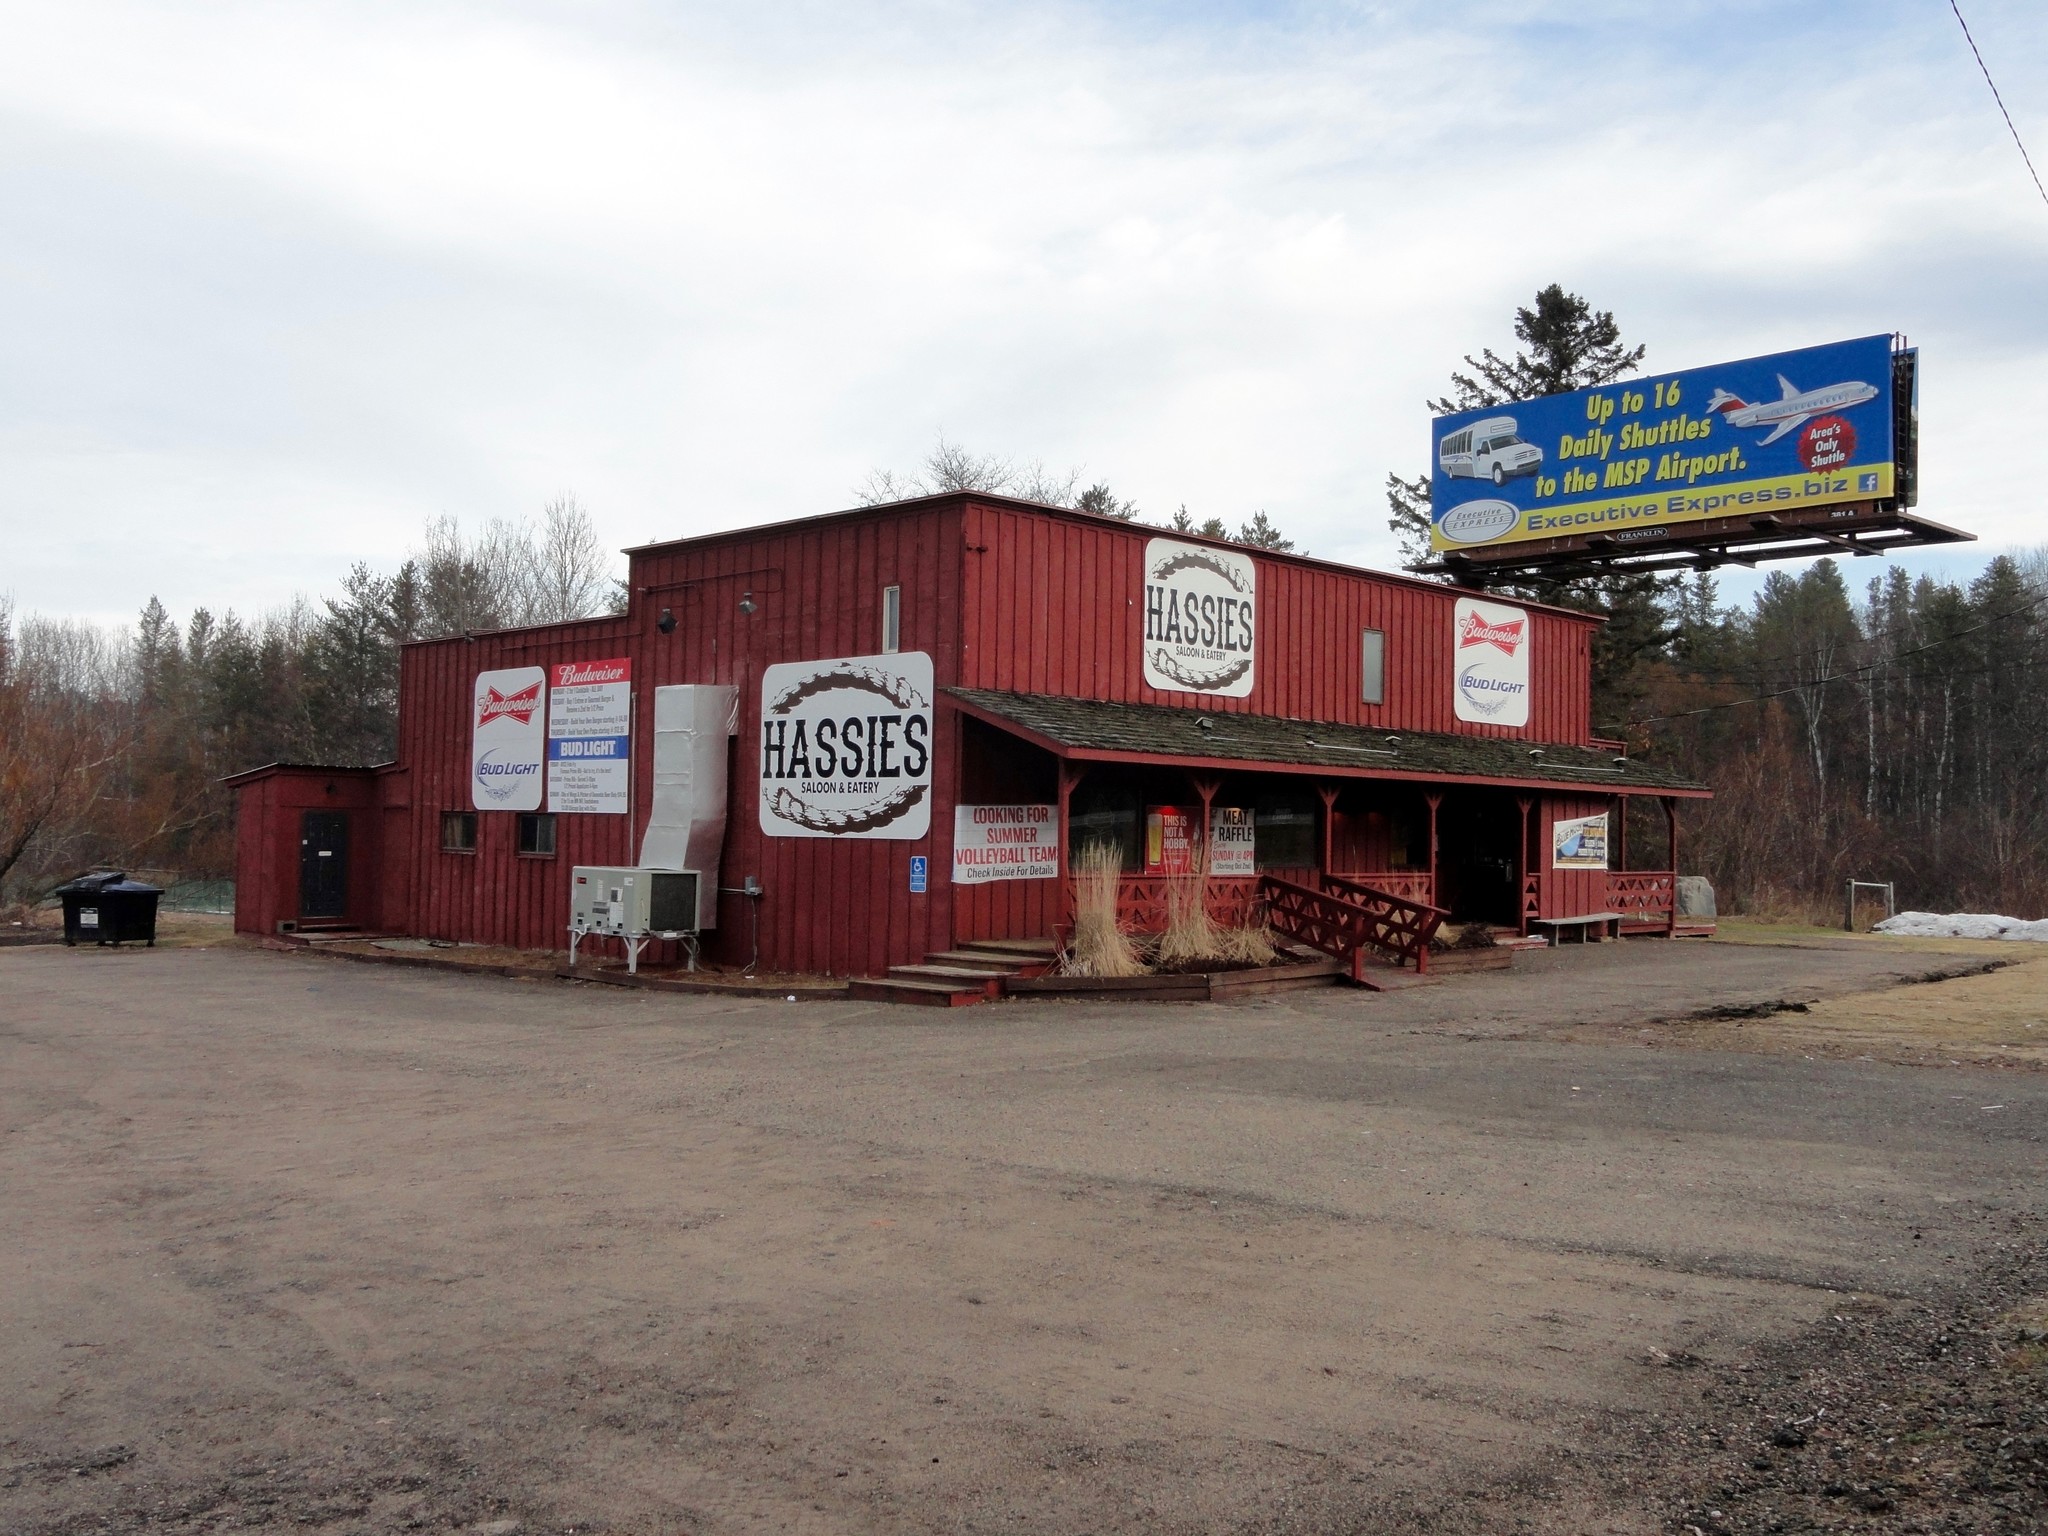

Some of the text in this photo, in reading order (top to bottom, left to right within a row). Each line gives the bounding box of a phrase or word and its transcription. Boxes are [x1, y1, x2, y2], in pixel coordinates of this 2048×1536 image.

[1586, 380, 1681, 425] Up to 16
[1559, 413, 1712, 460] Daily Shuttles
[1809, 423, 1841, 440] Area's
[1815, 437, 1839, 453] Only
[1811, 449, 1846, 468] Shuttle
[1535, 446, 1746, 498] to the MSP Airport.
[1527, 475, 1849, 531] Executive Express.biz
[1456, 507, 1502, 520] Executive
[1452, 516, 1505, 529] EXPRESS
[1620, 529, 1664, 540] FRANKLIN
[1146, 584, 1253, 653] HASSIES
[1458, 616, 1524, 645] Budweiser
[1175, 645, 1227, 662] SALOON & EATERY
[559, 663, 624, 686] Budweiser
[1463, 675, 1525, 694] BUD LIGHT
[477, 691, 541, 717] Budweiser
[560, 740, 617, 757] BUD LIGHT
[762, 713, 929, 779] HASSIES
[479, 763, 505, 776] BUD
[505, 763, 540, 776] LIGHT
[801, 781, 880, 794] SALOON & EATERY
[973, 806, 1049, 825] LOOKING FOR
[1163, 815, 1188, 827] THIS IS
[1222, 809, 1249, 826] MEAT
[986, 826, 1038, 844] SUMMER
[1163, 826, 1184, 838] NOT A
[1218, 826, 1253, 842] RAFFLE
[1163, 837, 1190, 850] HOBBY.
[955, 847, 1026, 866] VOLLEYBALL
[1212, 850, 1235, 861] SUNDAY
[967, 864, 1054, 879] Check Inside For Details
